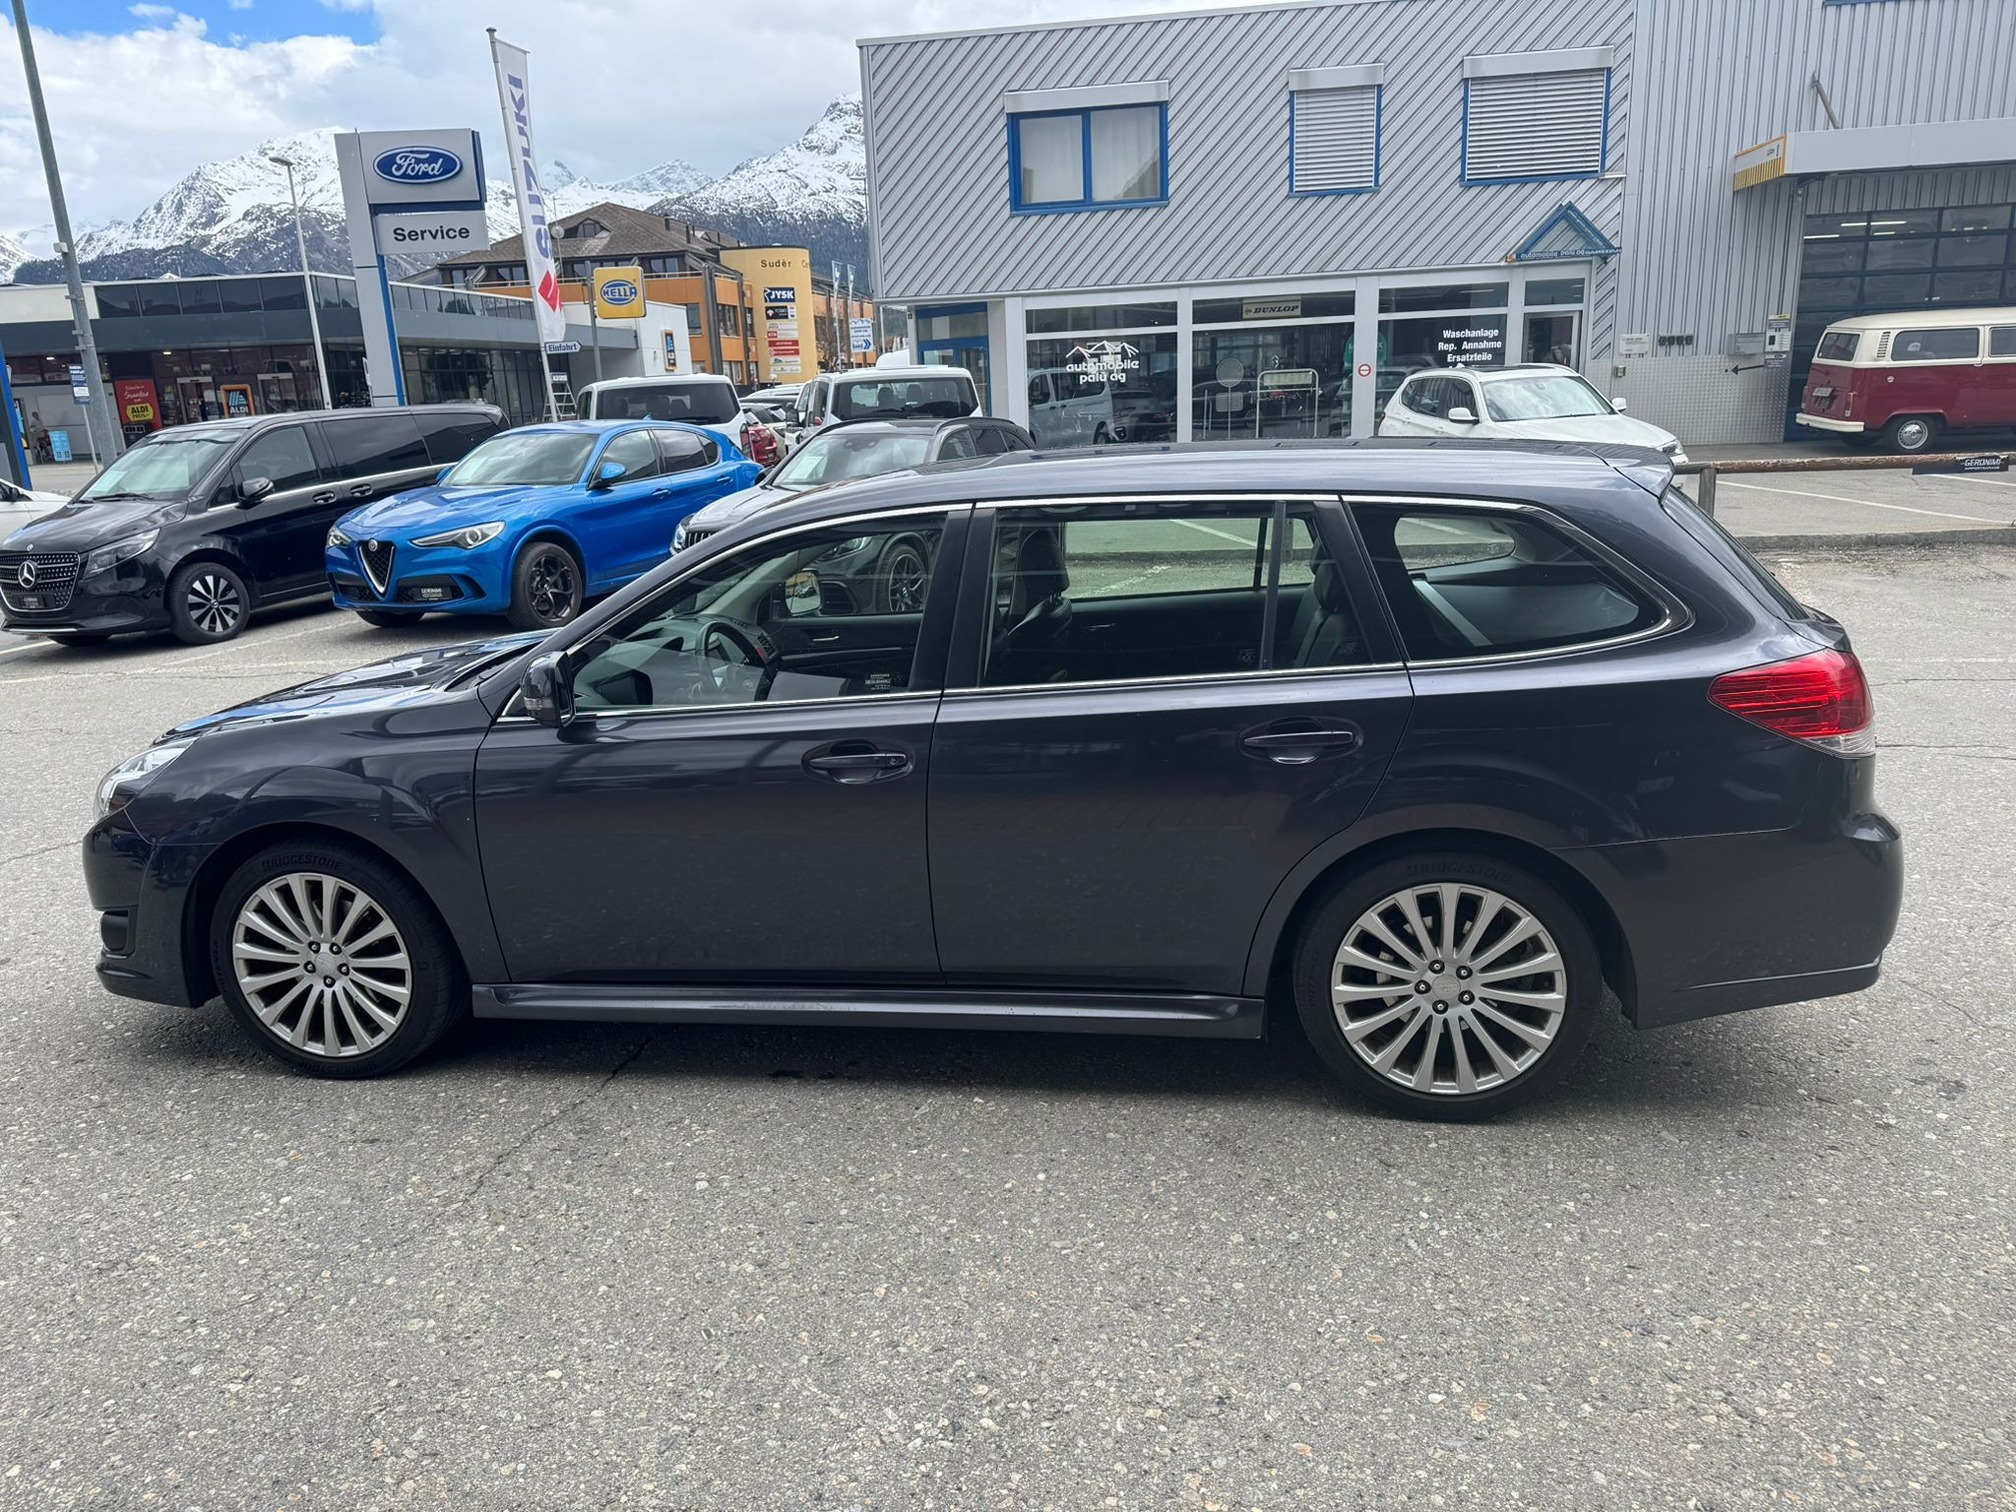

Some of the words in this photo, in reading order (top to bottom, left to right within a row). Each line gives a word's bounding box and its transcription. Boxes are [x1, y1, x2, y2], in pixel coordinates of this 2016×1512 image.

[391, 152, 443, 176] Ford
[507, 73, 551, 259] SUZUKI
[393, 225, 470, 242] Service
[602, 285, 638, 298] HELLA
[770, 290, 794, 299] JYSK
[1253, 305, 1299, 314] DUNLOP
[1442, 328, 1499, 339] Waschanlage
[548, 343, 577, 352] Einfahrt
[1437, 341, 1457, 352] Rep.
[1461, 340, 1502, 350] Annahme
[1446, 352, 1493, 363] Ersatzteile
[1066, 359, 1140, 372] automobile
[1109, 373, 1126, 383] ag
[131, 405, 149, 414] ALDI
